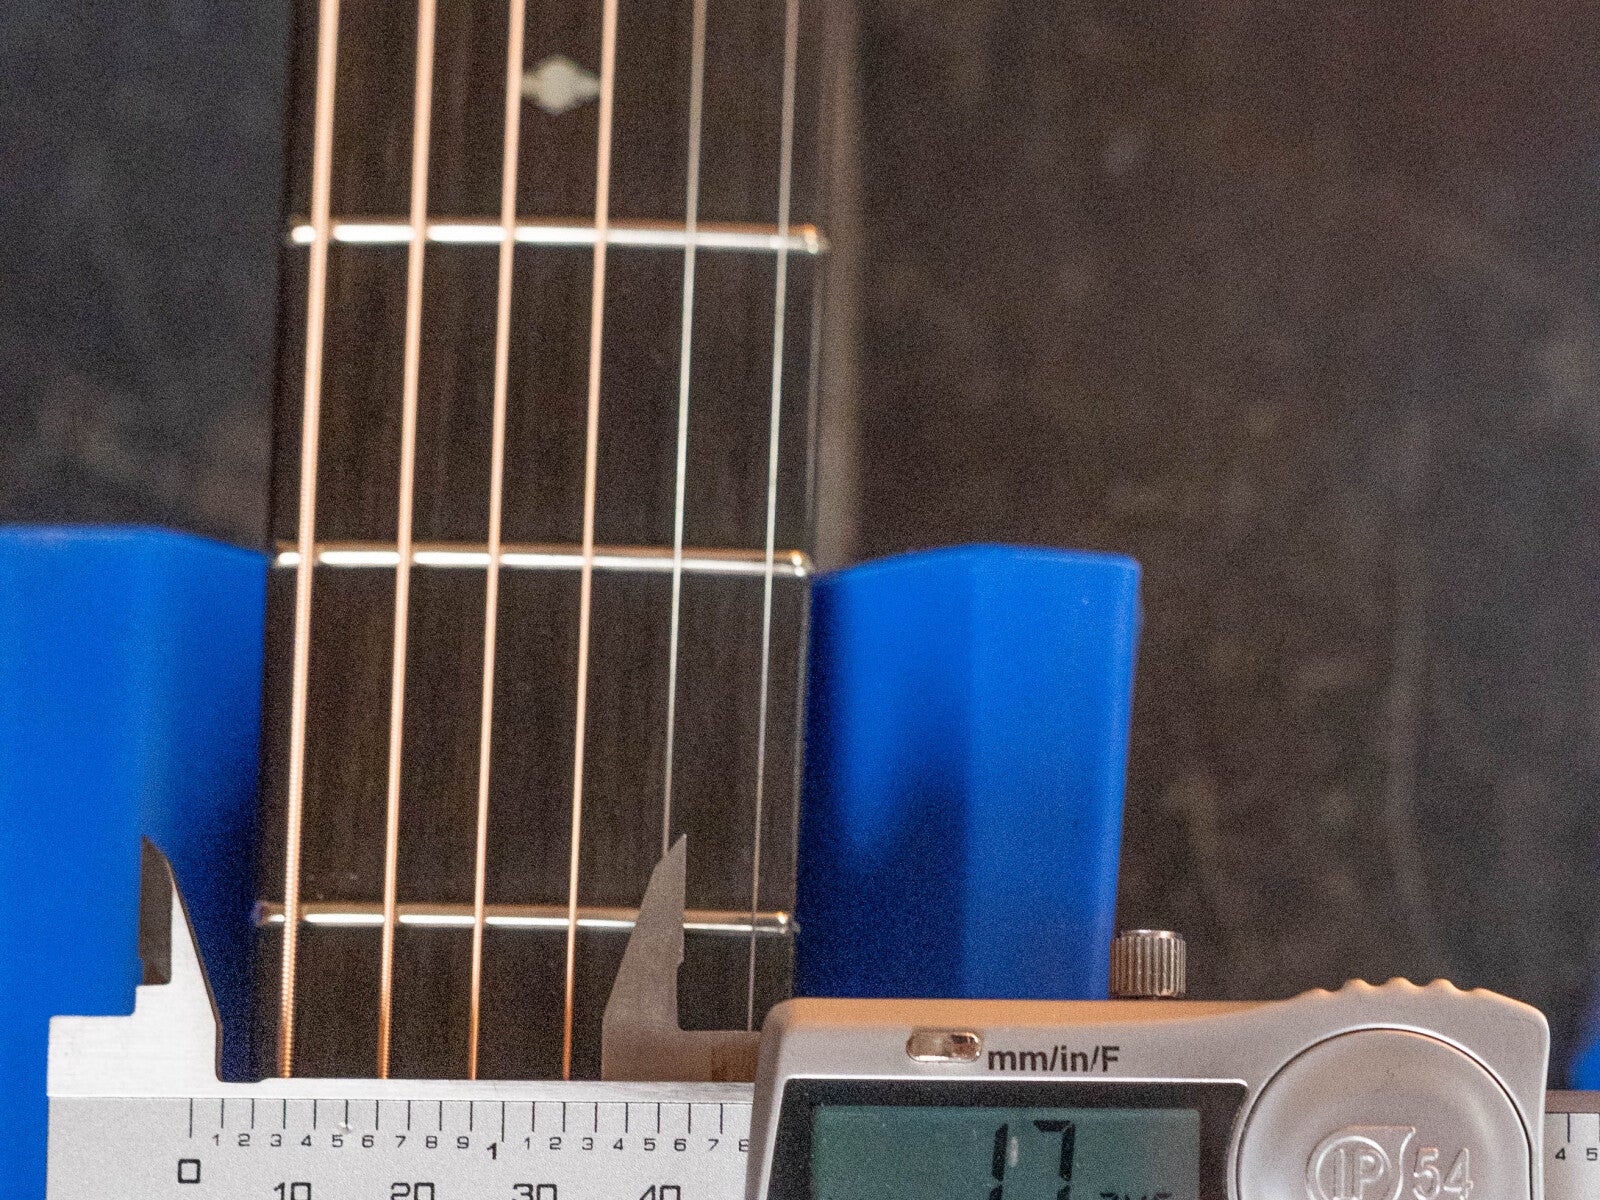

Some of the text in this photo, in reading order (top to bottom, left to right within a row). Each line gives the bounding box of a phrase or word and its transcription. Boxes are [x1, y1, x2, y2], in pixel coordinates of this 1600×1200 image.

[987, 1045, 1120, 1073] mm/in/F
[212, 1134, 220, 1146] 1
[238, 1134, 250, 1147] 2
[270, 1134, 282, 1147] 3
[301, 1135, 312, 1147] 4
[332, 1135, 343, 1148] 5
[362, 1135, 374, 1148] 6
[395, 1135, 406, 1148] 7
[425, 1136, 438, 1149] 8
[457, 1136, 469, 1149] 9
[487, 1143, 497, 1160] 1
[524, 1137, 531, 1150] 1
[550, 1137, 561, 1150] 2
[582, 1138, 594, 1150] 3
[613, 1138, 624, 1150] 4
[644, 1138, 656, 1151] 5
[674, 1138, 687, 1151] 6
[708, 1139, 719, 1151] 7
[1555, 1148, 1598, 1161] 4 5
[178, 1159, 200, 1184] 0
